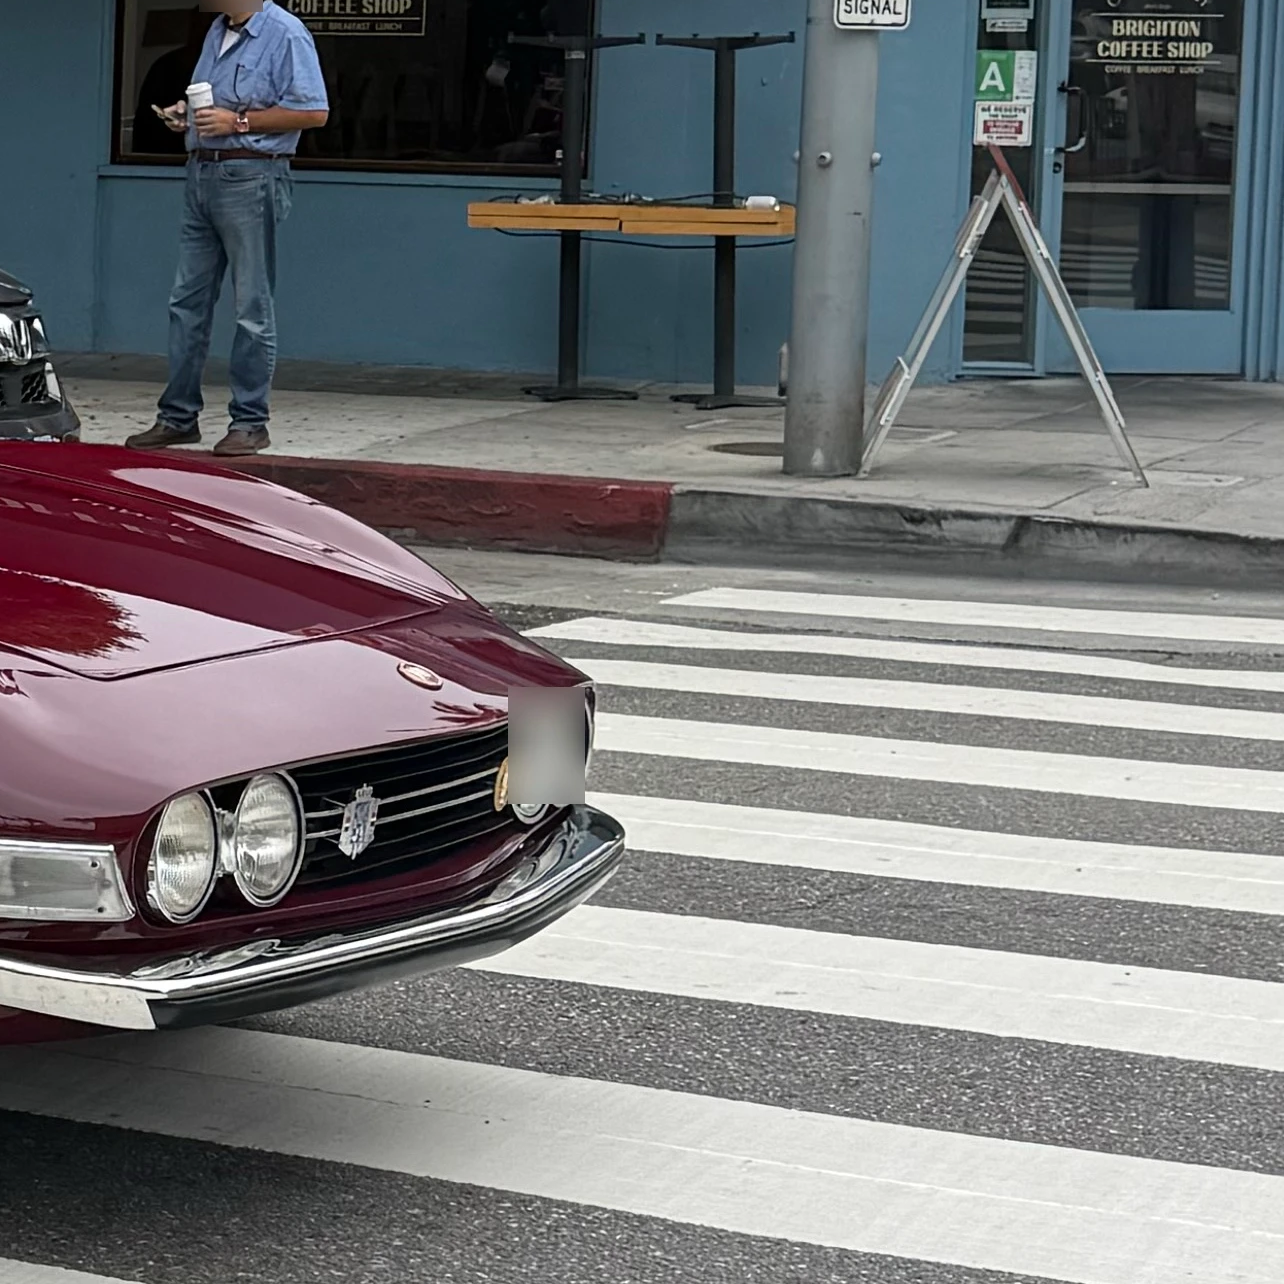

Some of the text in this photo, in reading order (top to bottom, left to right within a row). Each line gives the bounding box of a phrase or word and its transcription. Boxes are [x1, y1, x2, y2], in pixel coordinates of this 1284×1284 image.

[1112, 19, 1201, 37] BRIGHTON
[1097, 41, 1214, 58] COFFEE SHOP
[979, 61, 1006, 92] A
